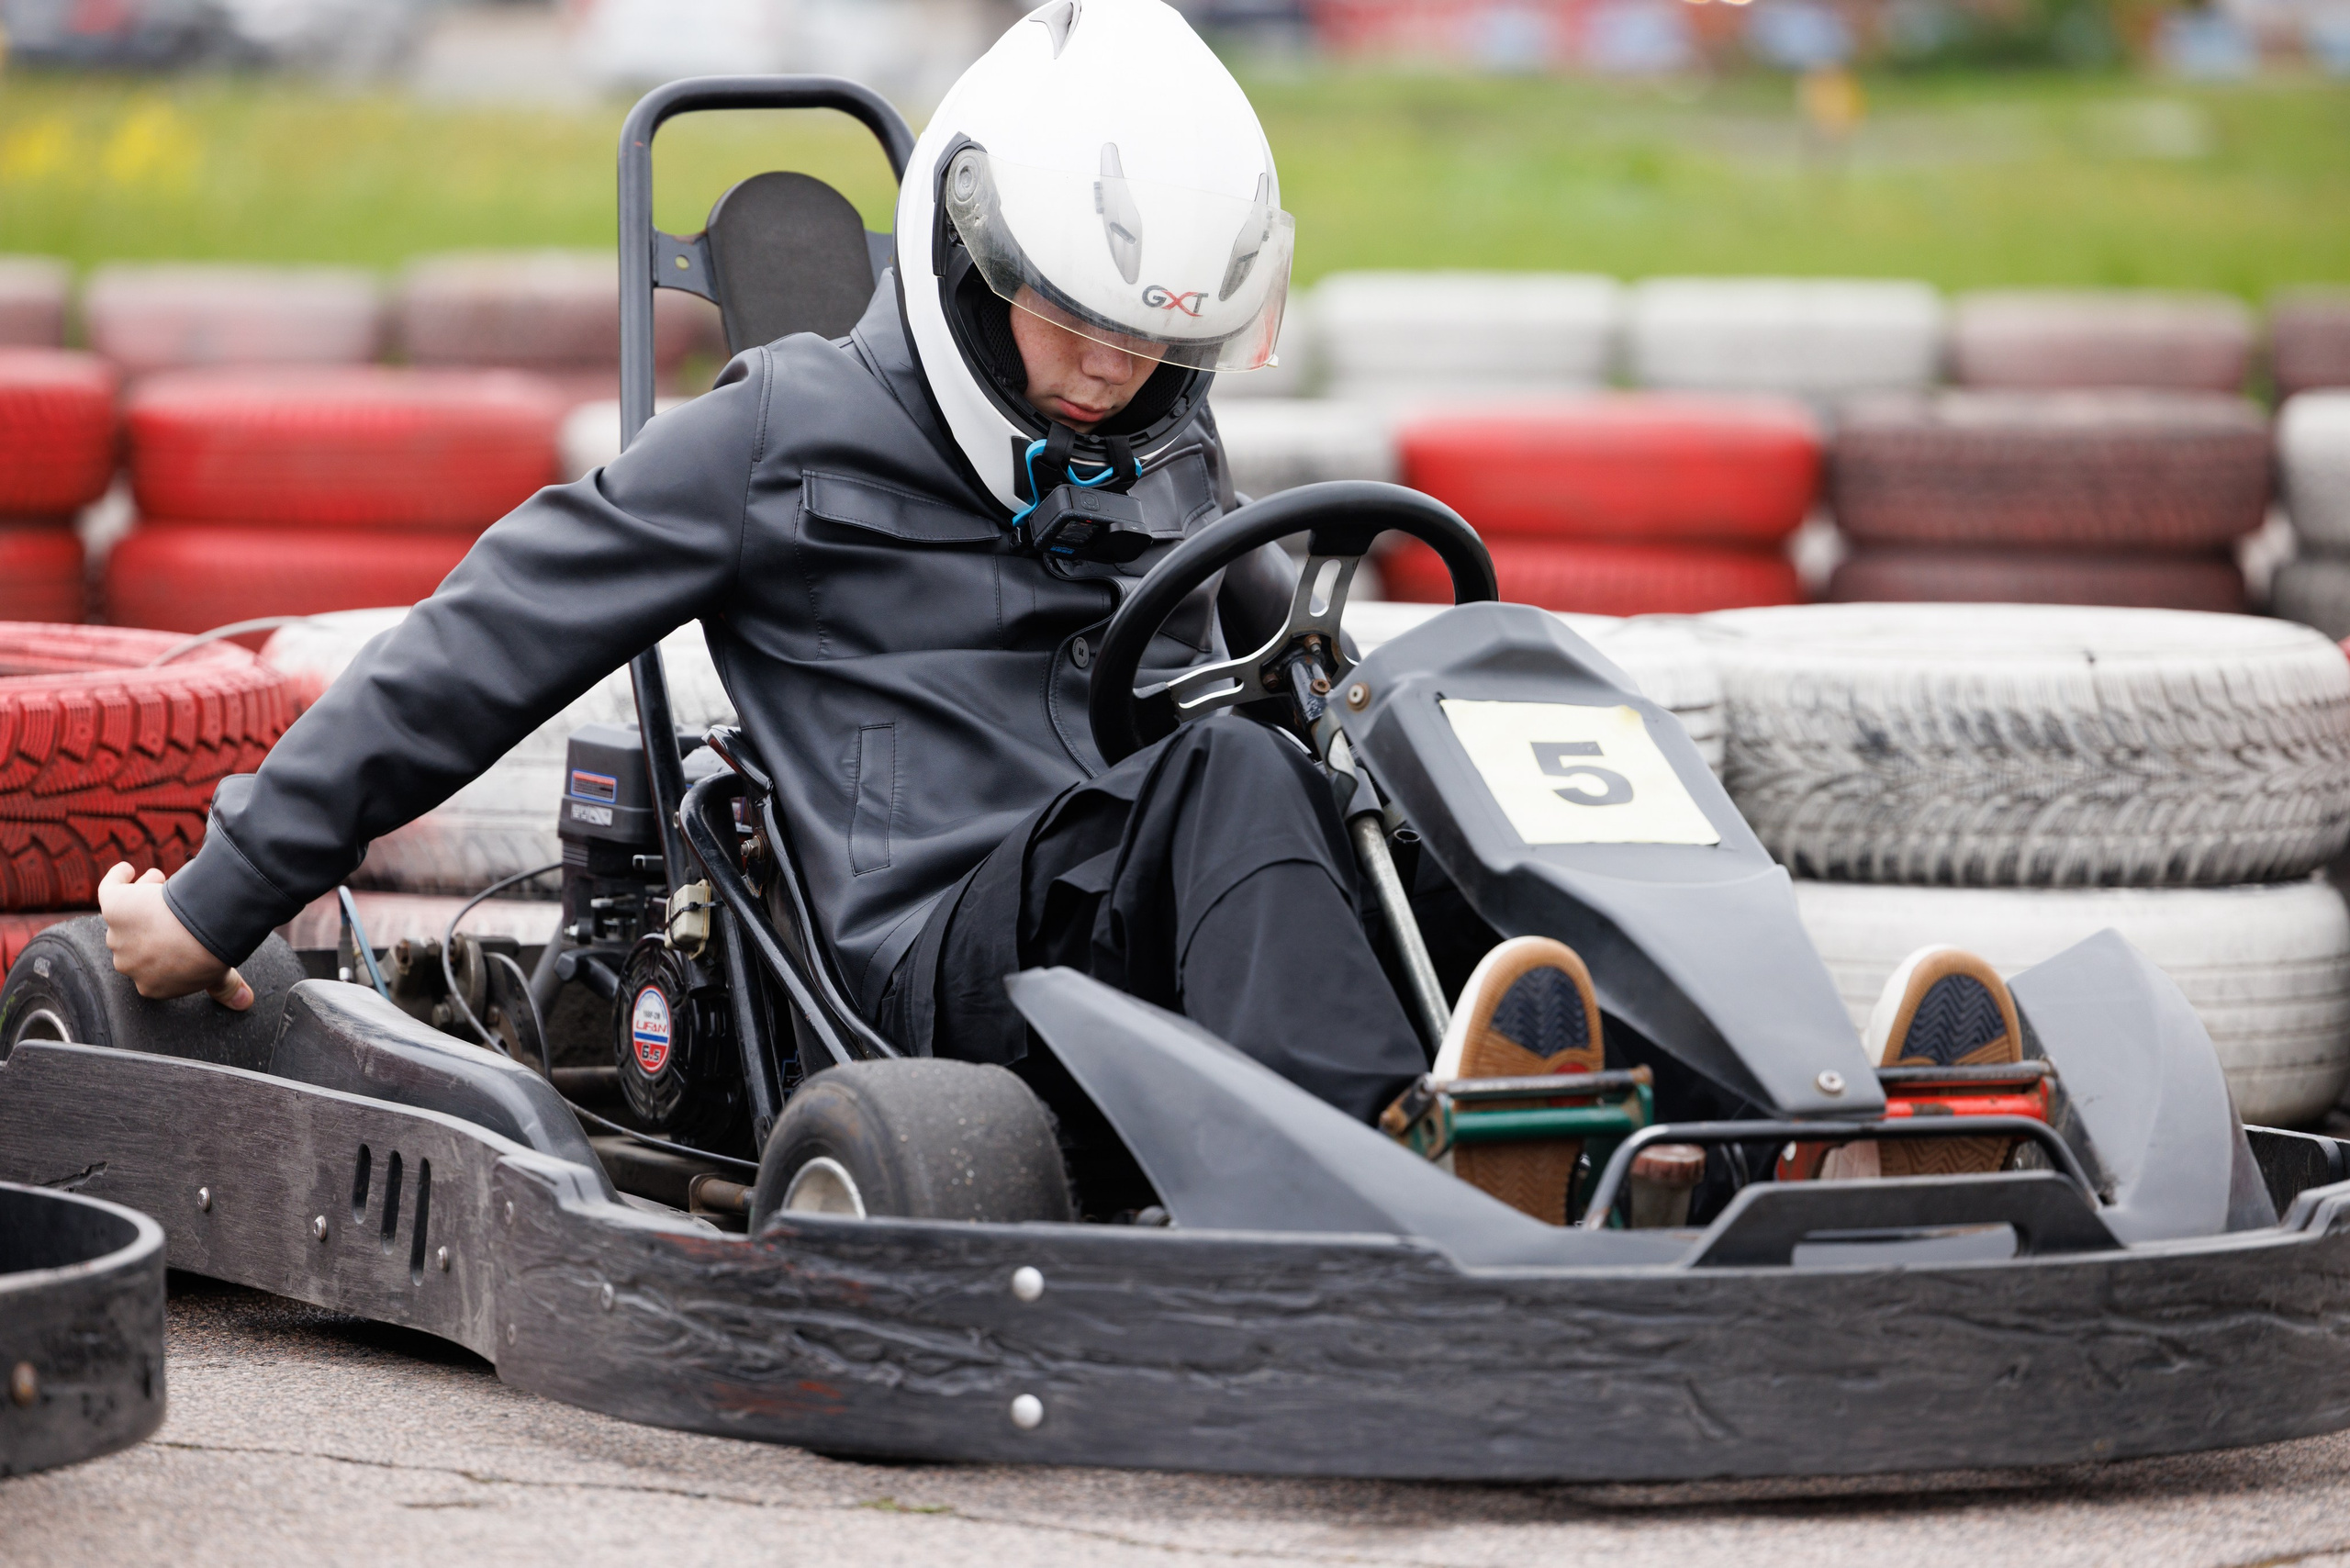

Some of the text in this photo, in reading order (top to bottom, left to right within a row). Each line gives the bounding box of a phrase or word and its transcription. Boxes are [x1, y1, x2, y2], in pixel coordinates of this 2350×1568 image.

[1141, 285, 1209, 318] GXT
[1529, 741, 1634, 806] 5
[636, 1020, 666, 1033] LIFAN
[642, 1044, 660, 1061] 6.5
